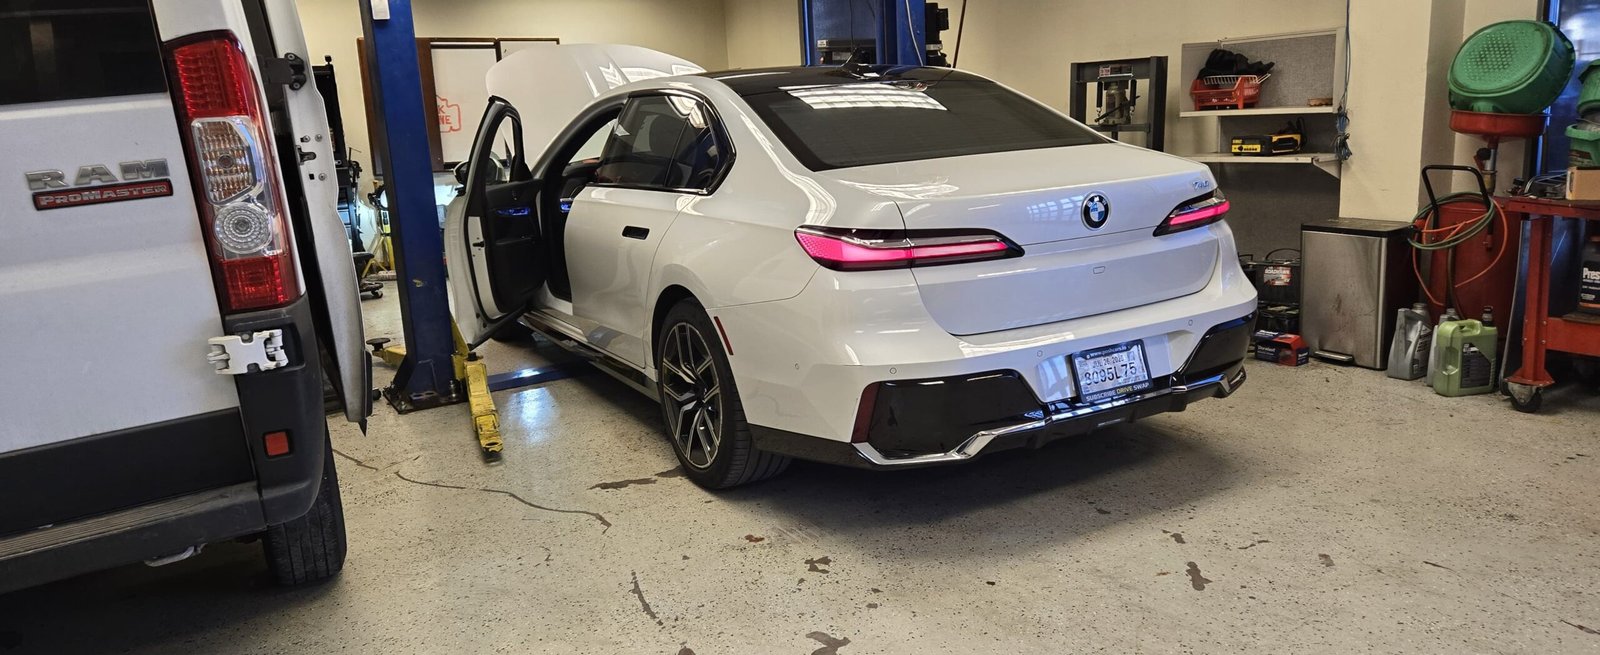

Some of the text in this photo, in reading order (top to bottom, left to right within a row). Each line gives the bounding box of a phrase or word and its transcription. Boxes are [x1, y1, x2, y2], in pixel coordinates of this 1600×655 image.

[25, 158, 170, 191] RAM
[38, 184, 167, 205] PROMASTER
[1086, 382, 1149, 401] SUBSCRIBE DRIVE SWAP
